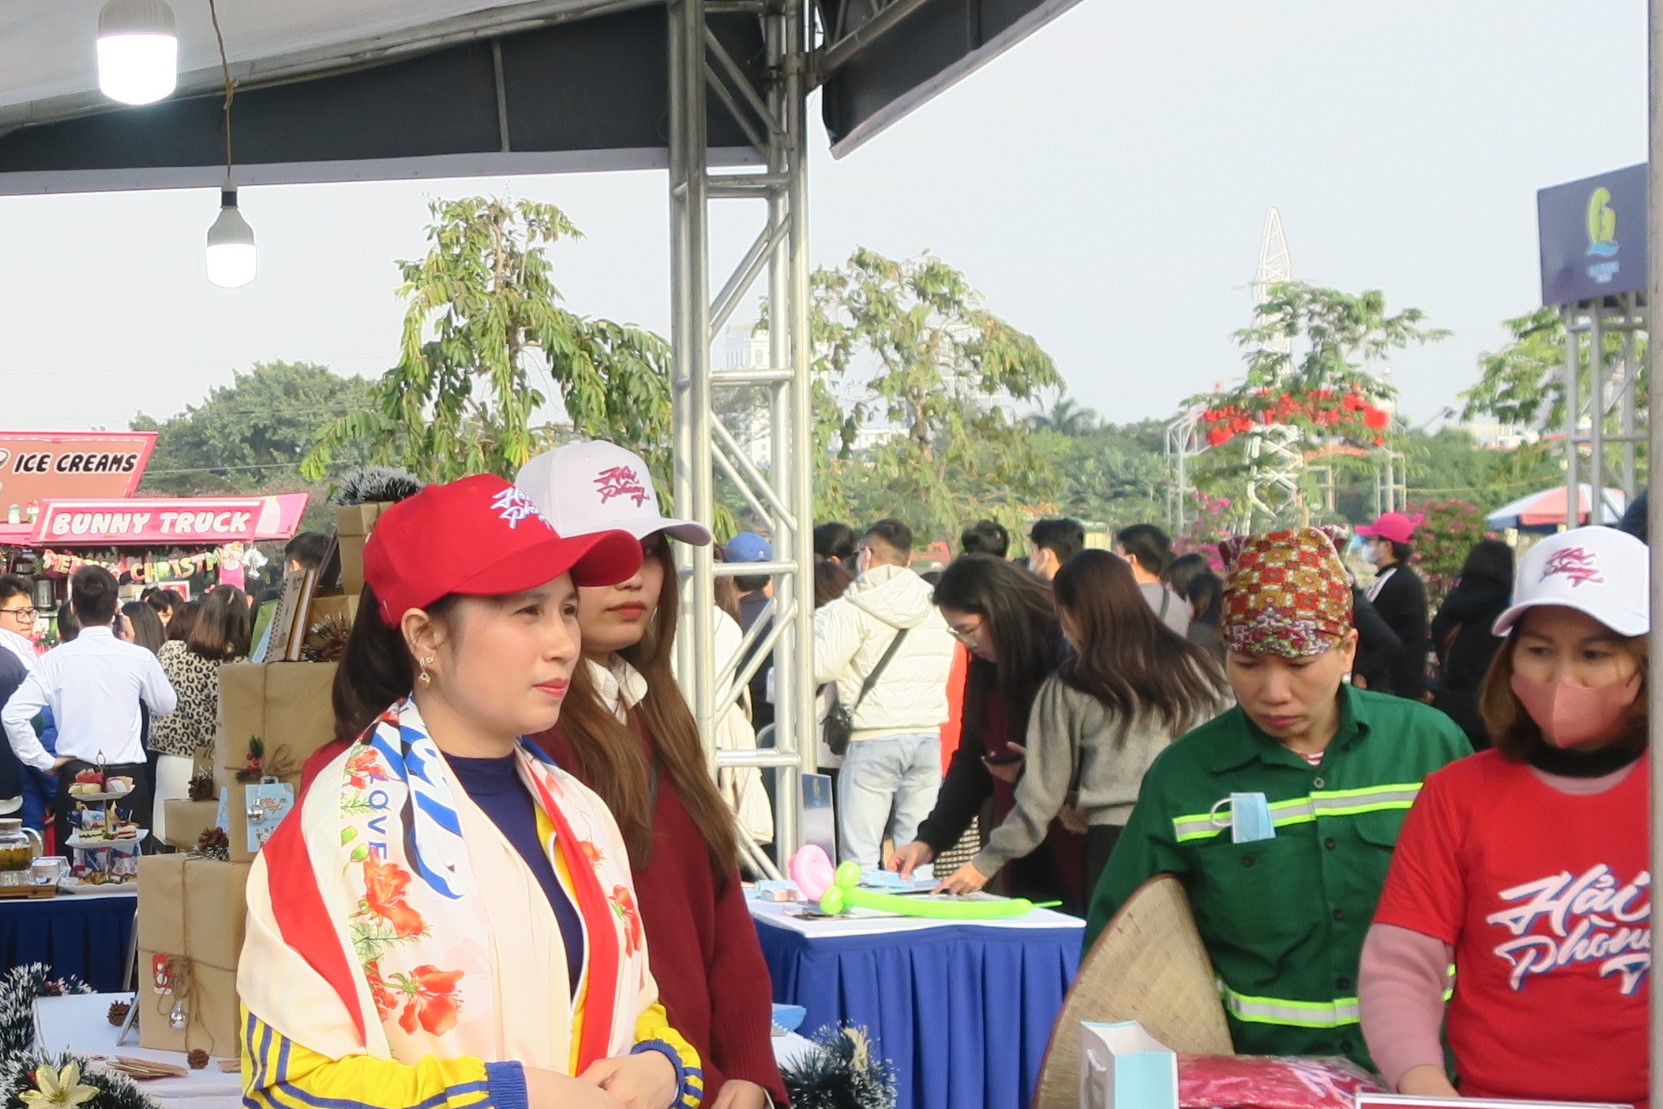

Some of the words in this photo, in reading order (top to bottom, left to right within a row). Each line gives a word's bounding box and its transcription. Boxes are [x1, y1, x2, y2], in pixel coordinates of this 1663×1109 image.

[15, 453, 51, 473] ICE
[56, 453, 139, 473] CREAMS
[51, 511, 152, 535] BUNNY
[159, 510, 252, 533] TRUCK
[1486, 863, 1651, 937] Hải
